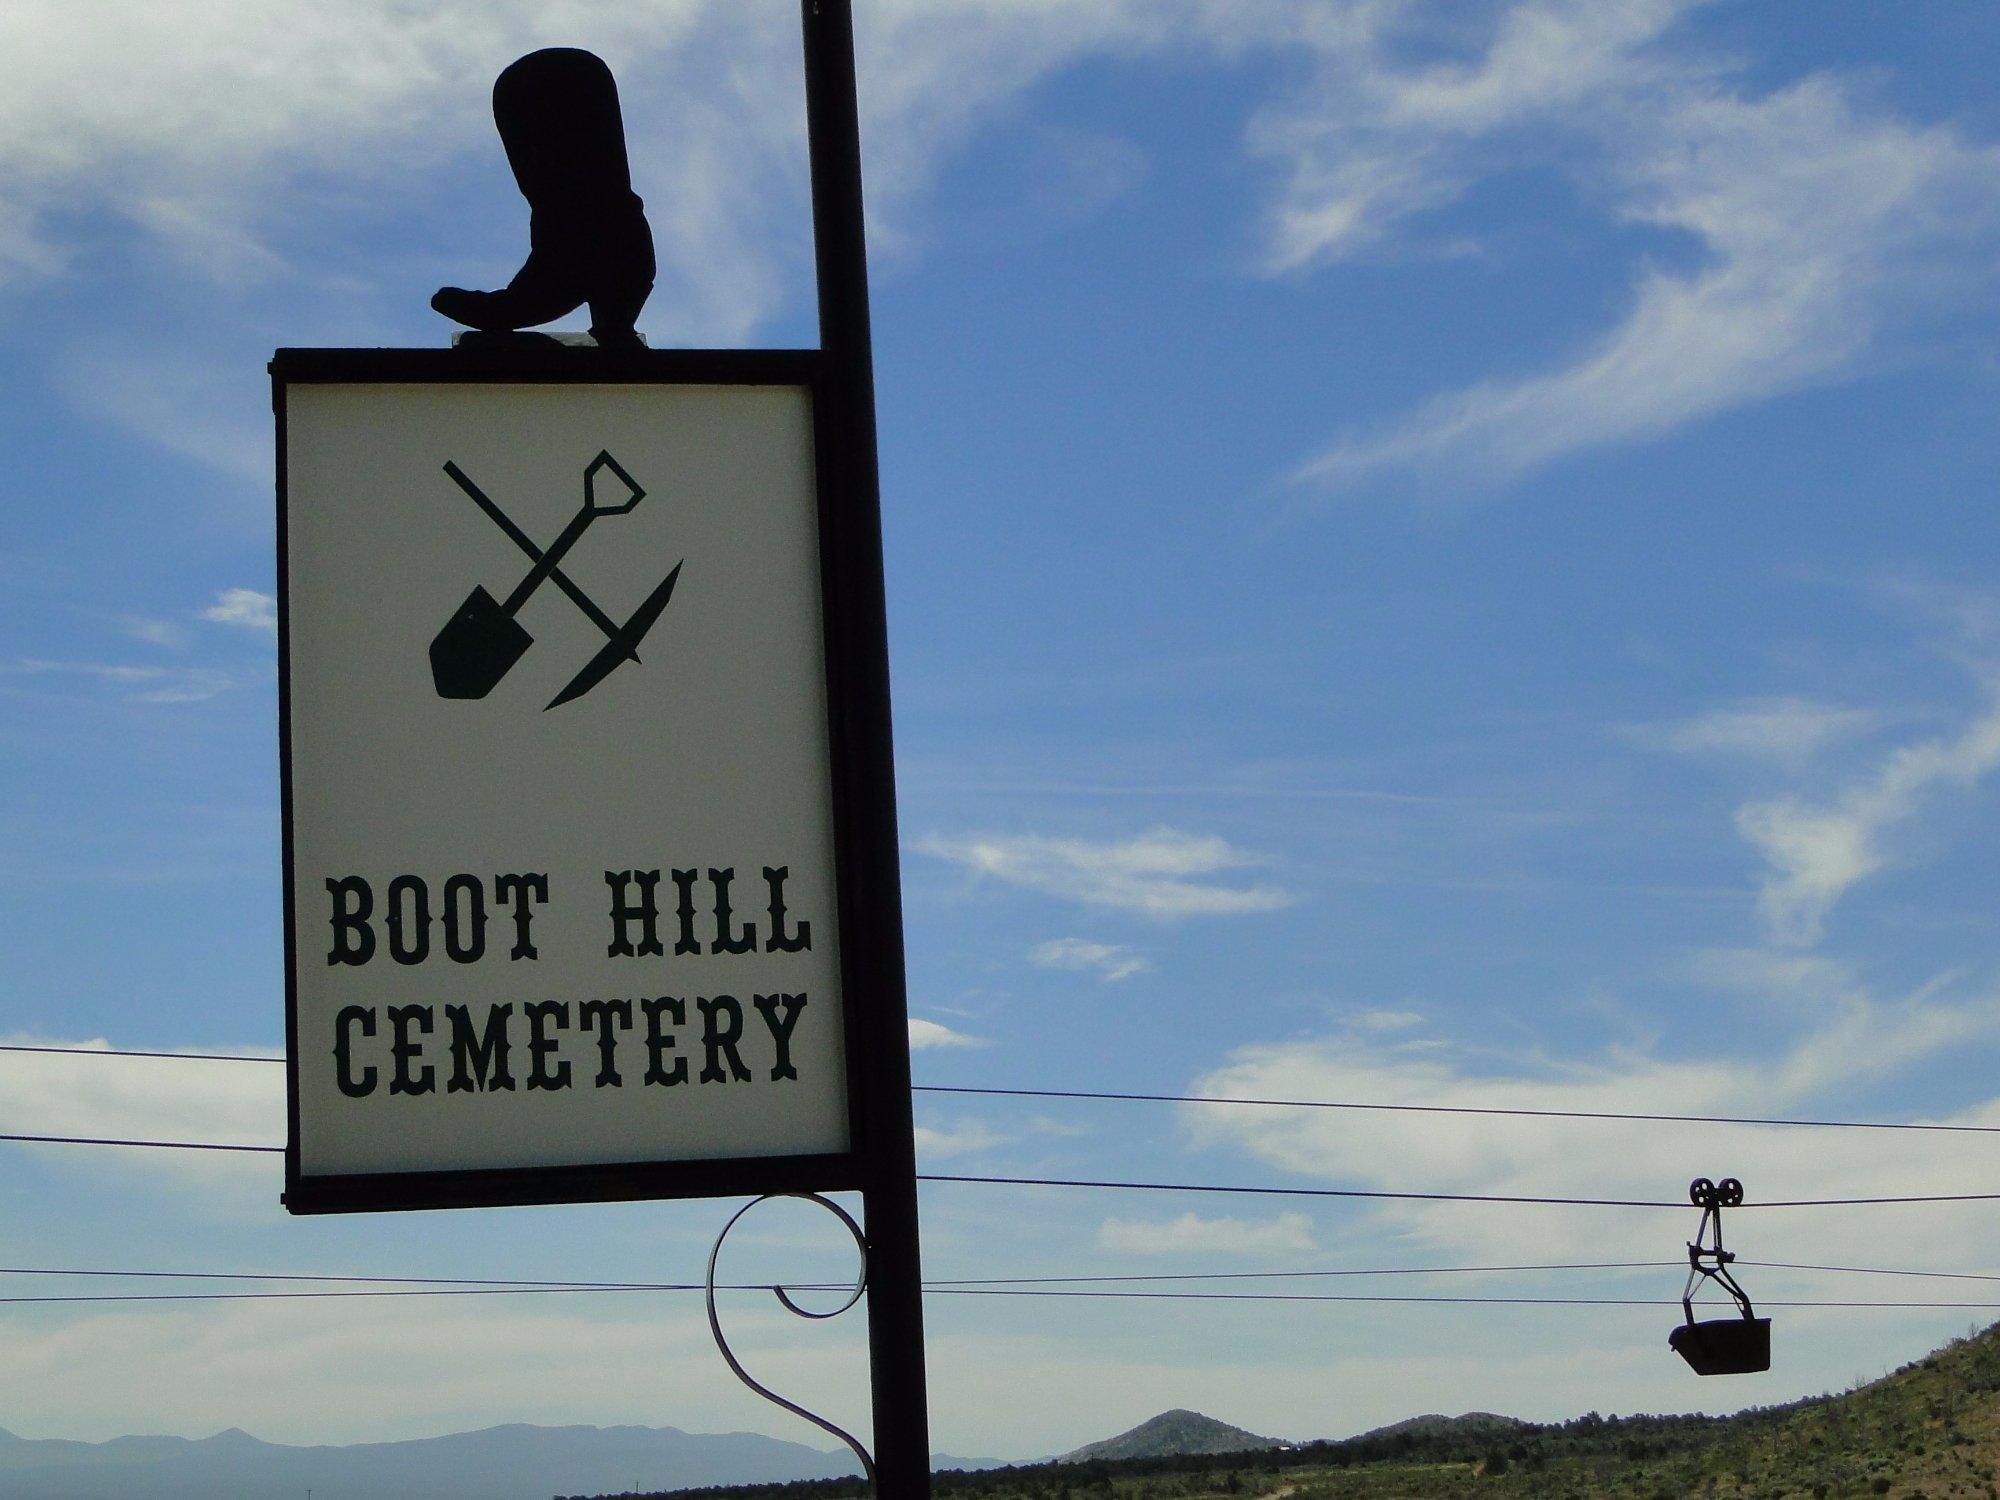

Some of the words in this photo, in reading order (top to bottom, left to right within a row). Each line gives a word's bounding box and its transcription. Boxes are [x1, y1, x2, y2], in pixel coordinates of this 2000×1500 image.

[325, 873, 549, 966] BOOT
[604, 866, 813, 958] HILL
[332, 992, 808, 1098] CEMETERY
